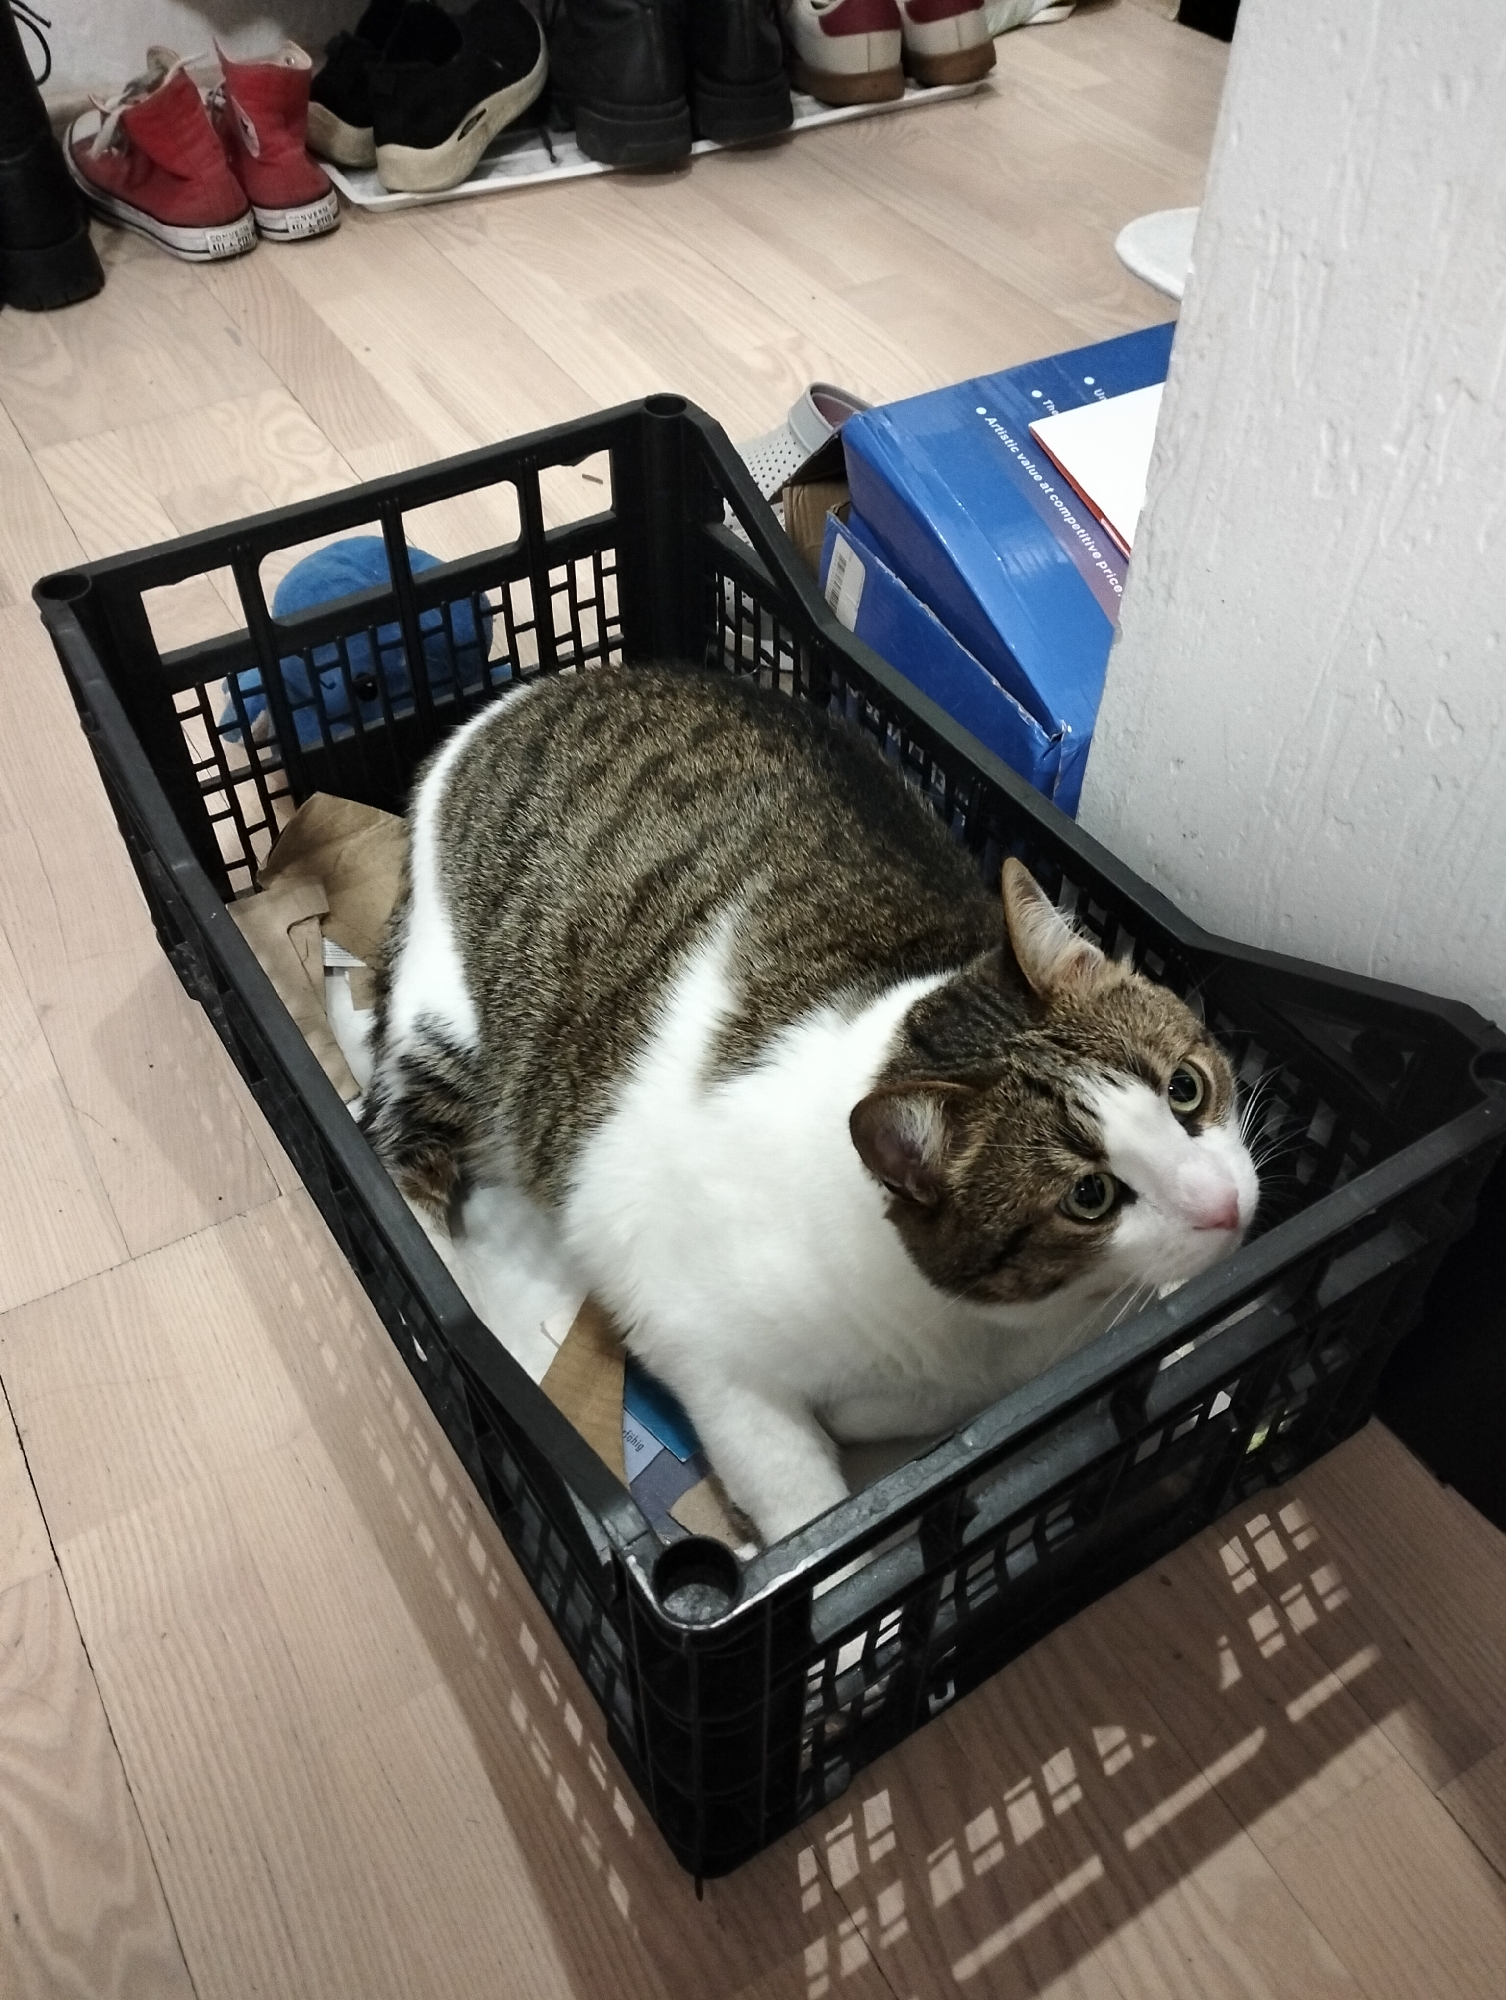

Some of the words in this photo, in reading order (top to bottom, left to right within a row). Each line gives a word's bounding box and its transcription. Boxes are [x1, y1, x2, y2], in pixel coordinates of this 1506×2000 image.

[985, 416, 1019, 453] Artistic
[1017, 455, 1043, 481] value
[1039, 481, 1054, 494] at
[1050, 493, 1102, 560] competitive
[1096, 560, 1123, 597] price.
